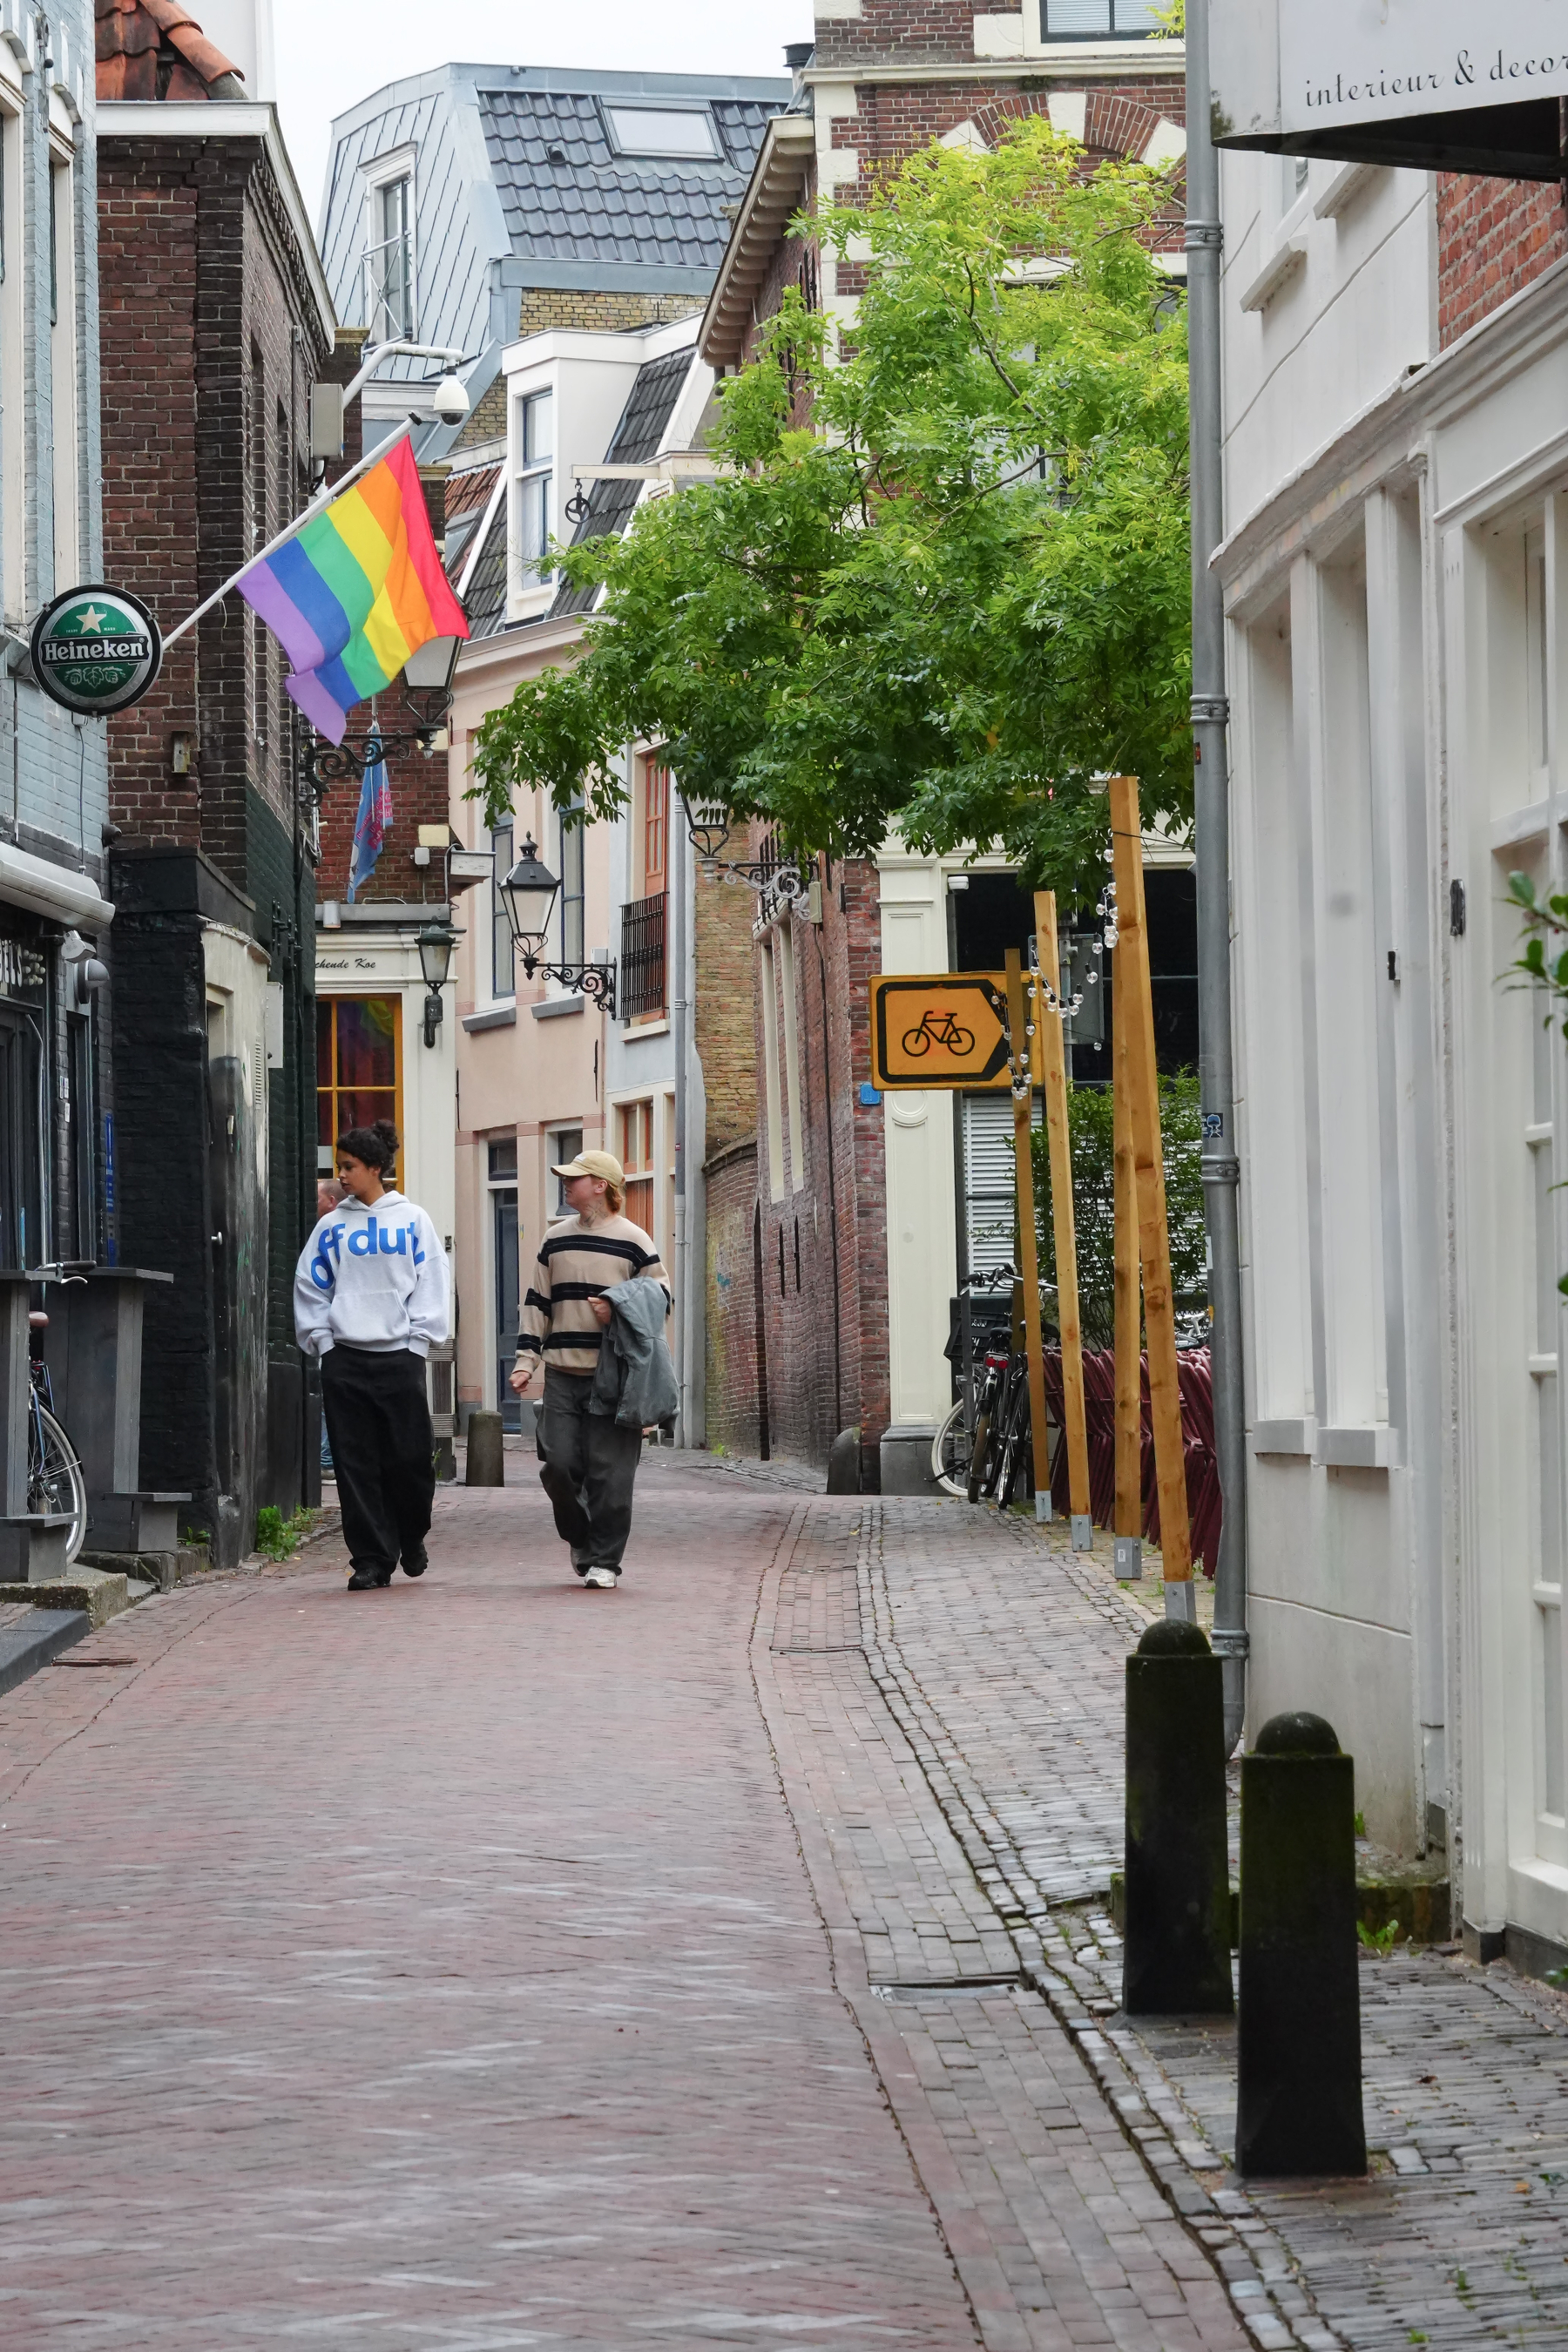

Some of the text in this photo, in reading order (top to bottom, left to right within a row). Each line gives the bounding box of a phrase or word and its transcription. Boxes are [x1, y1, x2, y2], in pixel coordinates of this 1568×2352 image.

[1306, 69, 1444, 107] interieur
[1454, 49, 1477, 85] &
[44, 639, 145, 662] Heineken
[355, 957, 376, 969] Koe
[311, 1223, 346, 1290] off
